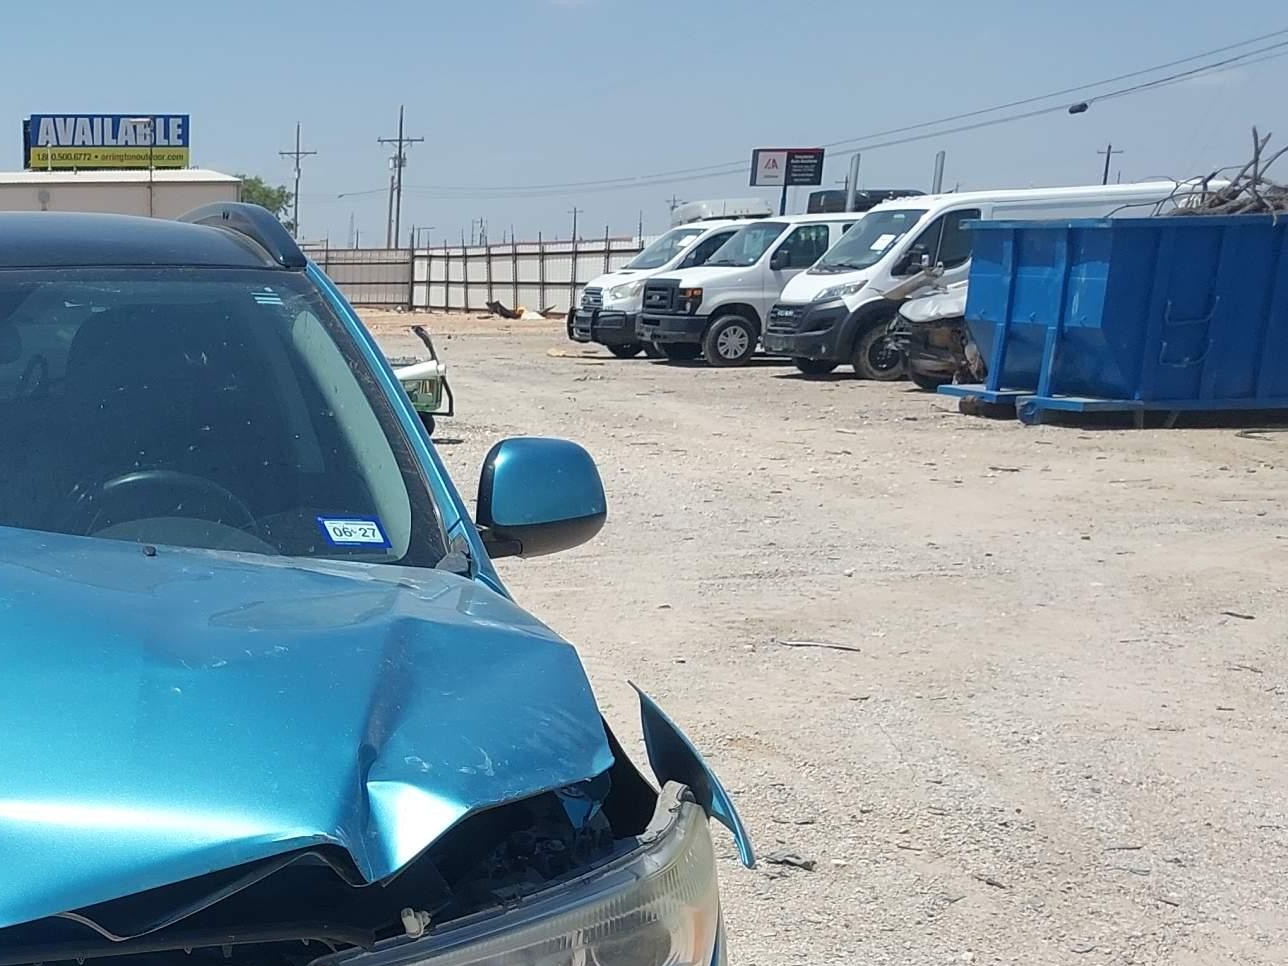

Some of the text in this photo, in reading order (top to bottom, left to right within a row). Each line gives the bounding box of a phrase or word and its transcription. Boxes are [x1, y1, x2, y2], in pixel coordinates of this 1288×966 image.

[37, 117, 183, 146] AVAILABLE
[332, 526, 376, 538] 06 27
